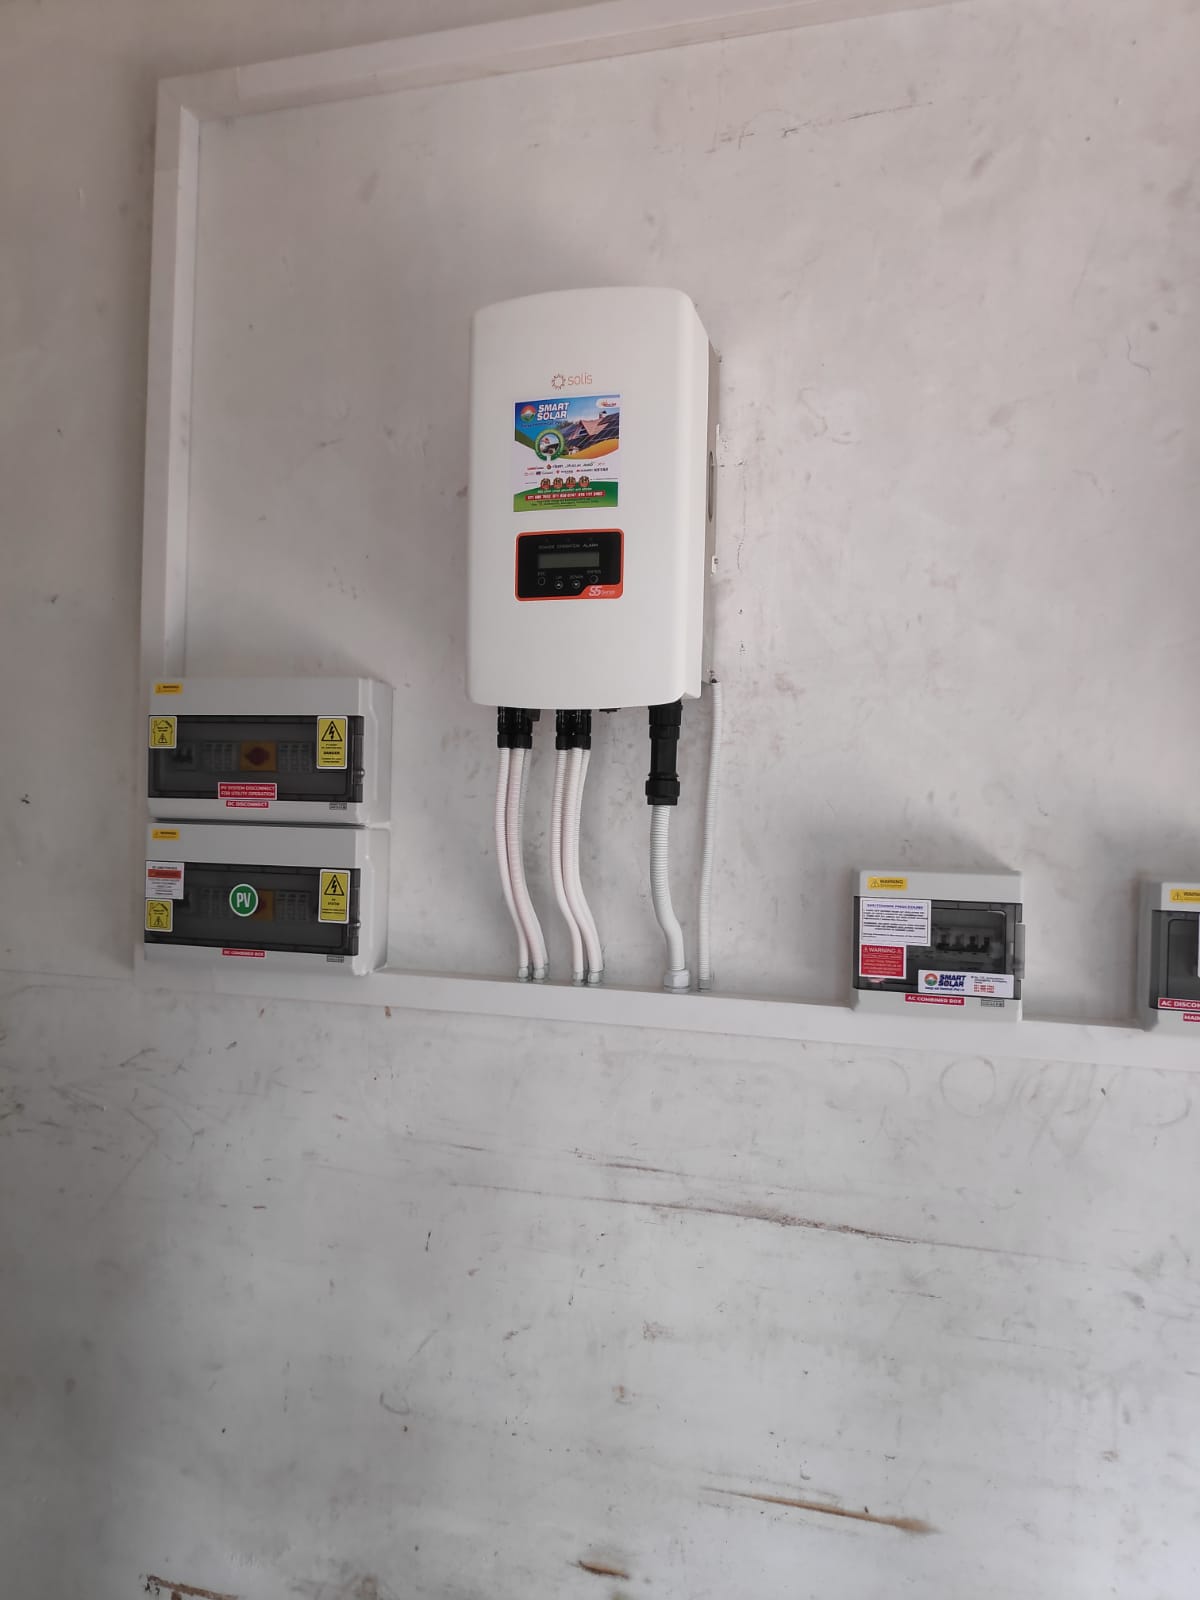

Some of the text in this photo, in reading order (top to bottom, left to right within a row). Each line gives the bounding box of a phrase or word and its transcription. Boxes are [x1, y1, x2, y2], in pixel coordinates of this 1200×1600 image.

[567, 372, 593, 386] solis
[538, 402, 569, 412] SMART
[537, 411, 567, 421] SOLAR
[236, 892, 251, 908] PV
[938, 979, 965, 987] SOLAR
